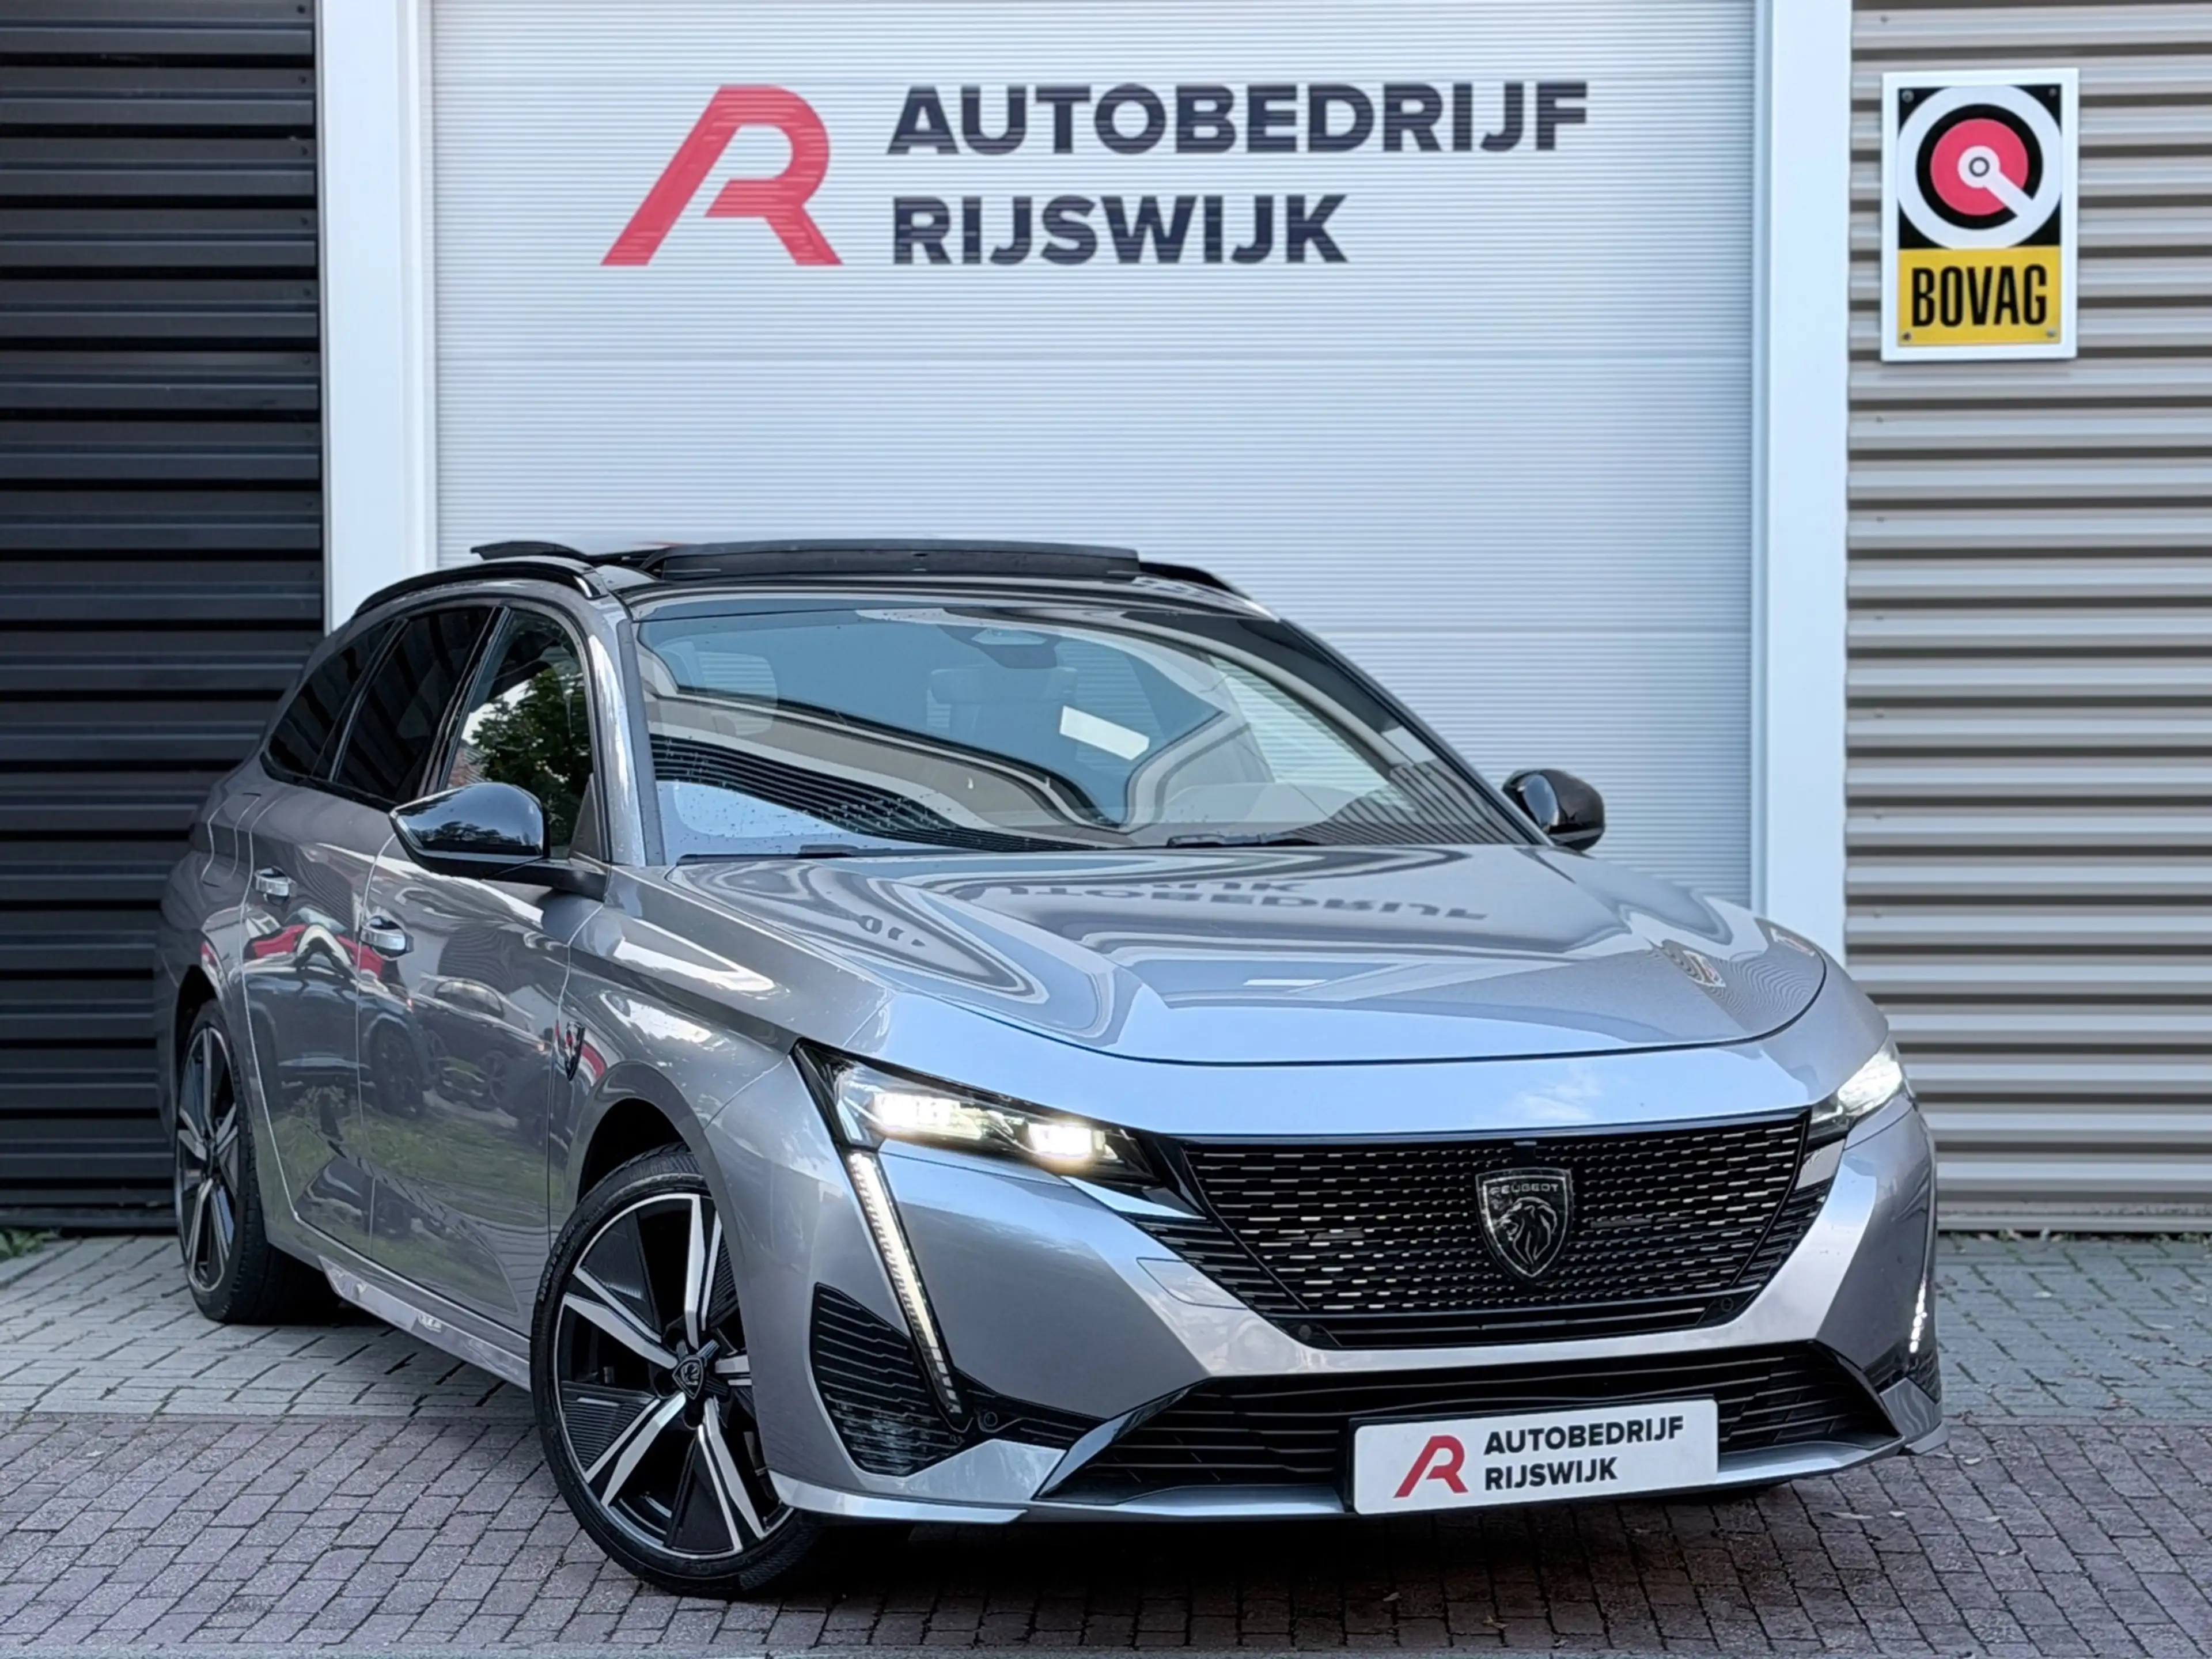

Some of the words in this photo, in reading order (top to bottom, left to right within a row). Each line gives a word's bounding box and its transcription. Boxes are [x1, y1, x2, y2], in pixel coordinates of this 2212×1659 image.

[888, 82, 1588, 155] AUTOBEDRIJF
[893, 194, 1348, 265] RIJSWIJK
[1912, 264, 2047, 327] BOVAG
[1483, 1415, 1684, 1455] AUTOBEDRIJF
[1484, 1457, 1618, 1491] RIJSWIJK
